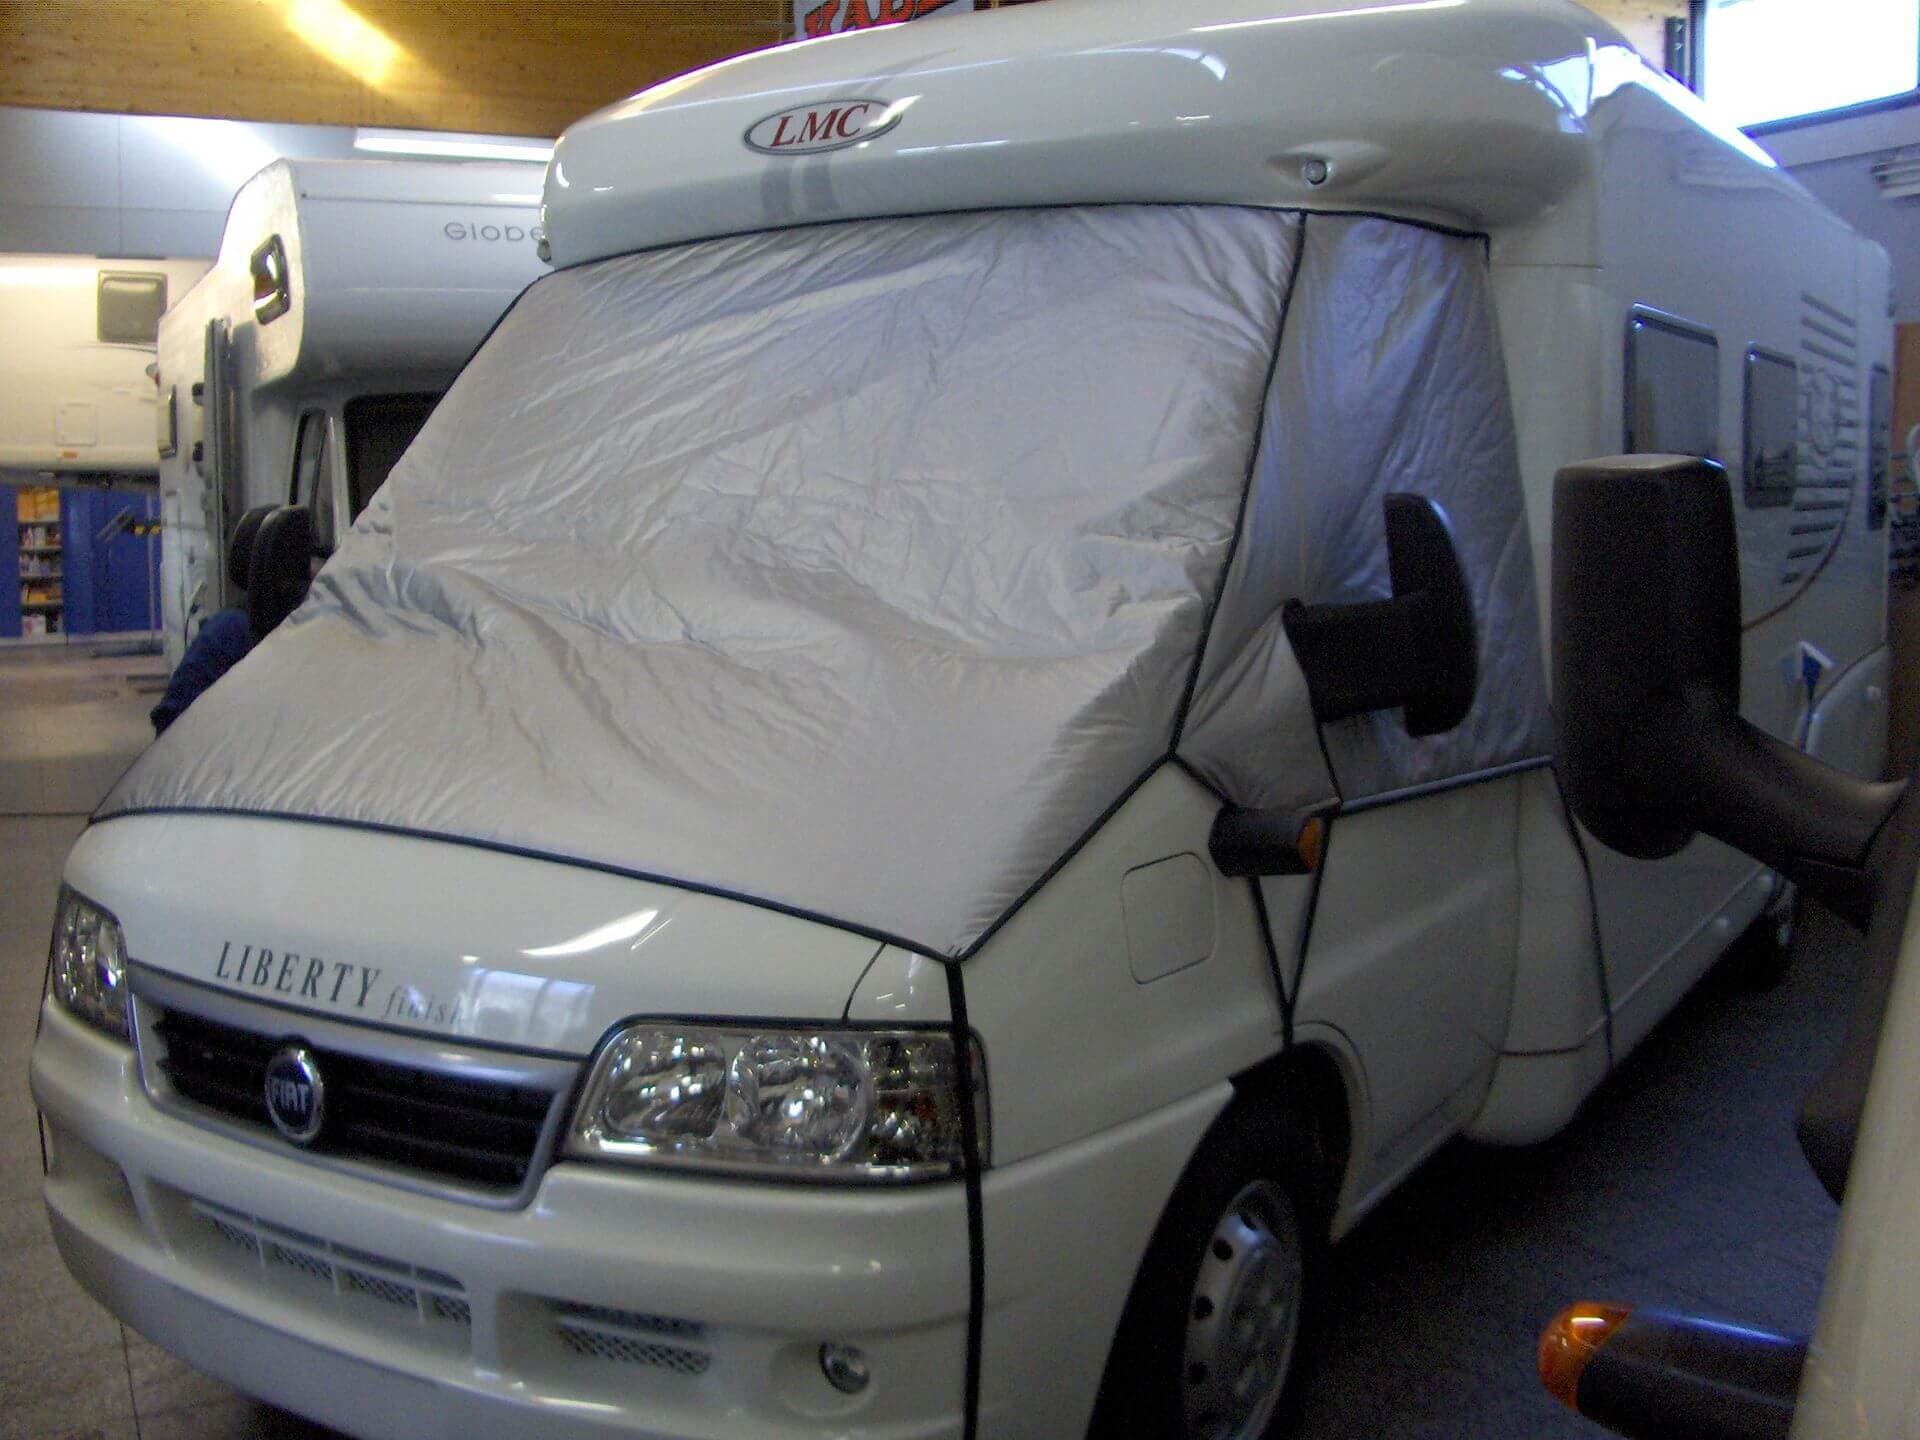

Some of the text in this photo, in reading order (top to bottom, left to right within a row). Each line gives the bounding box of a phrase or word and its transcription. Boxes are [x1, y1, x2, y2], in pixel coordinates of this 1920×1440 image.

[770, 103, 869, 147] LMC
[216, 941, 382, 1008] LIBERTY
[271, 1077, 309, 1113] FIAT
